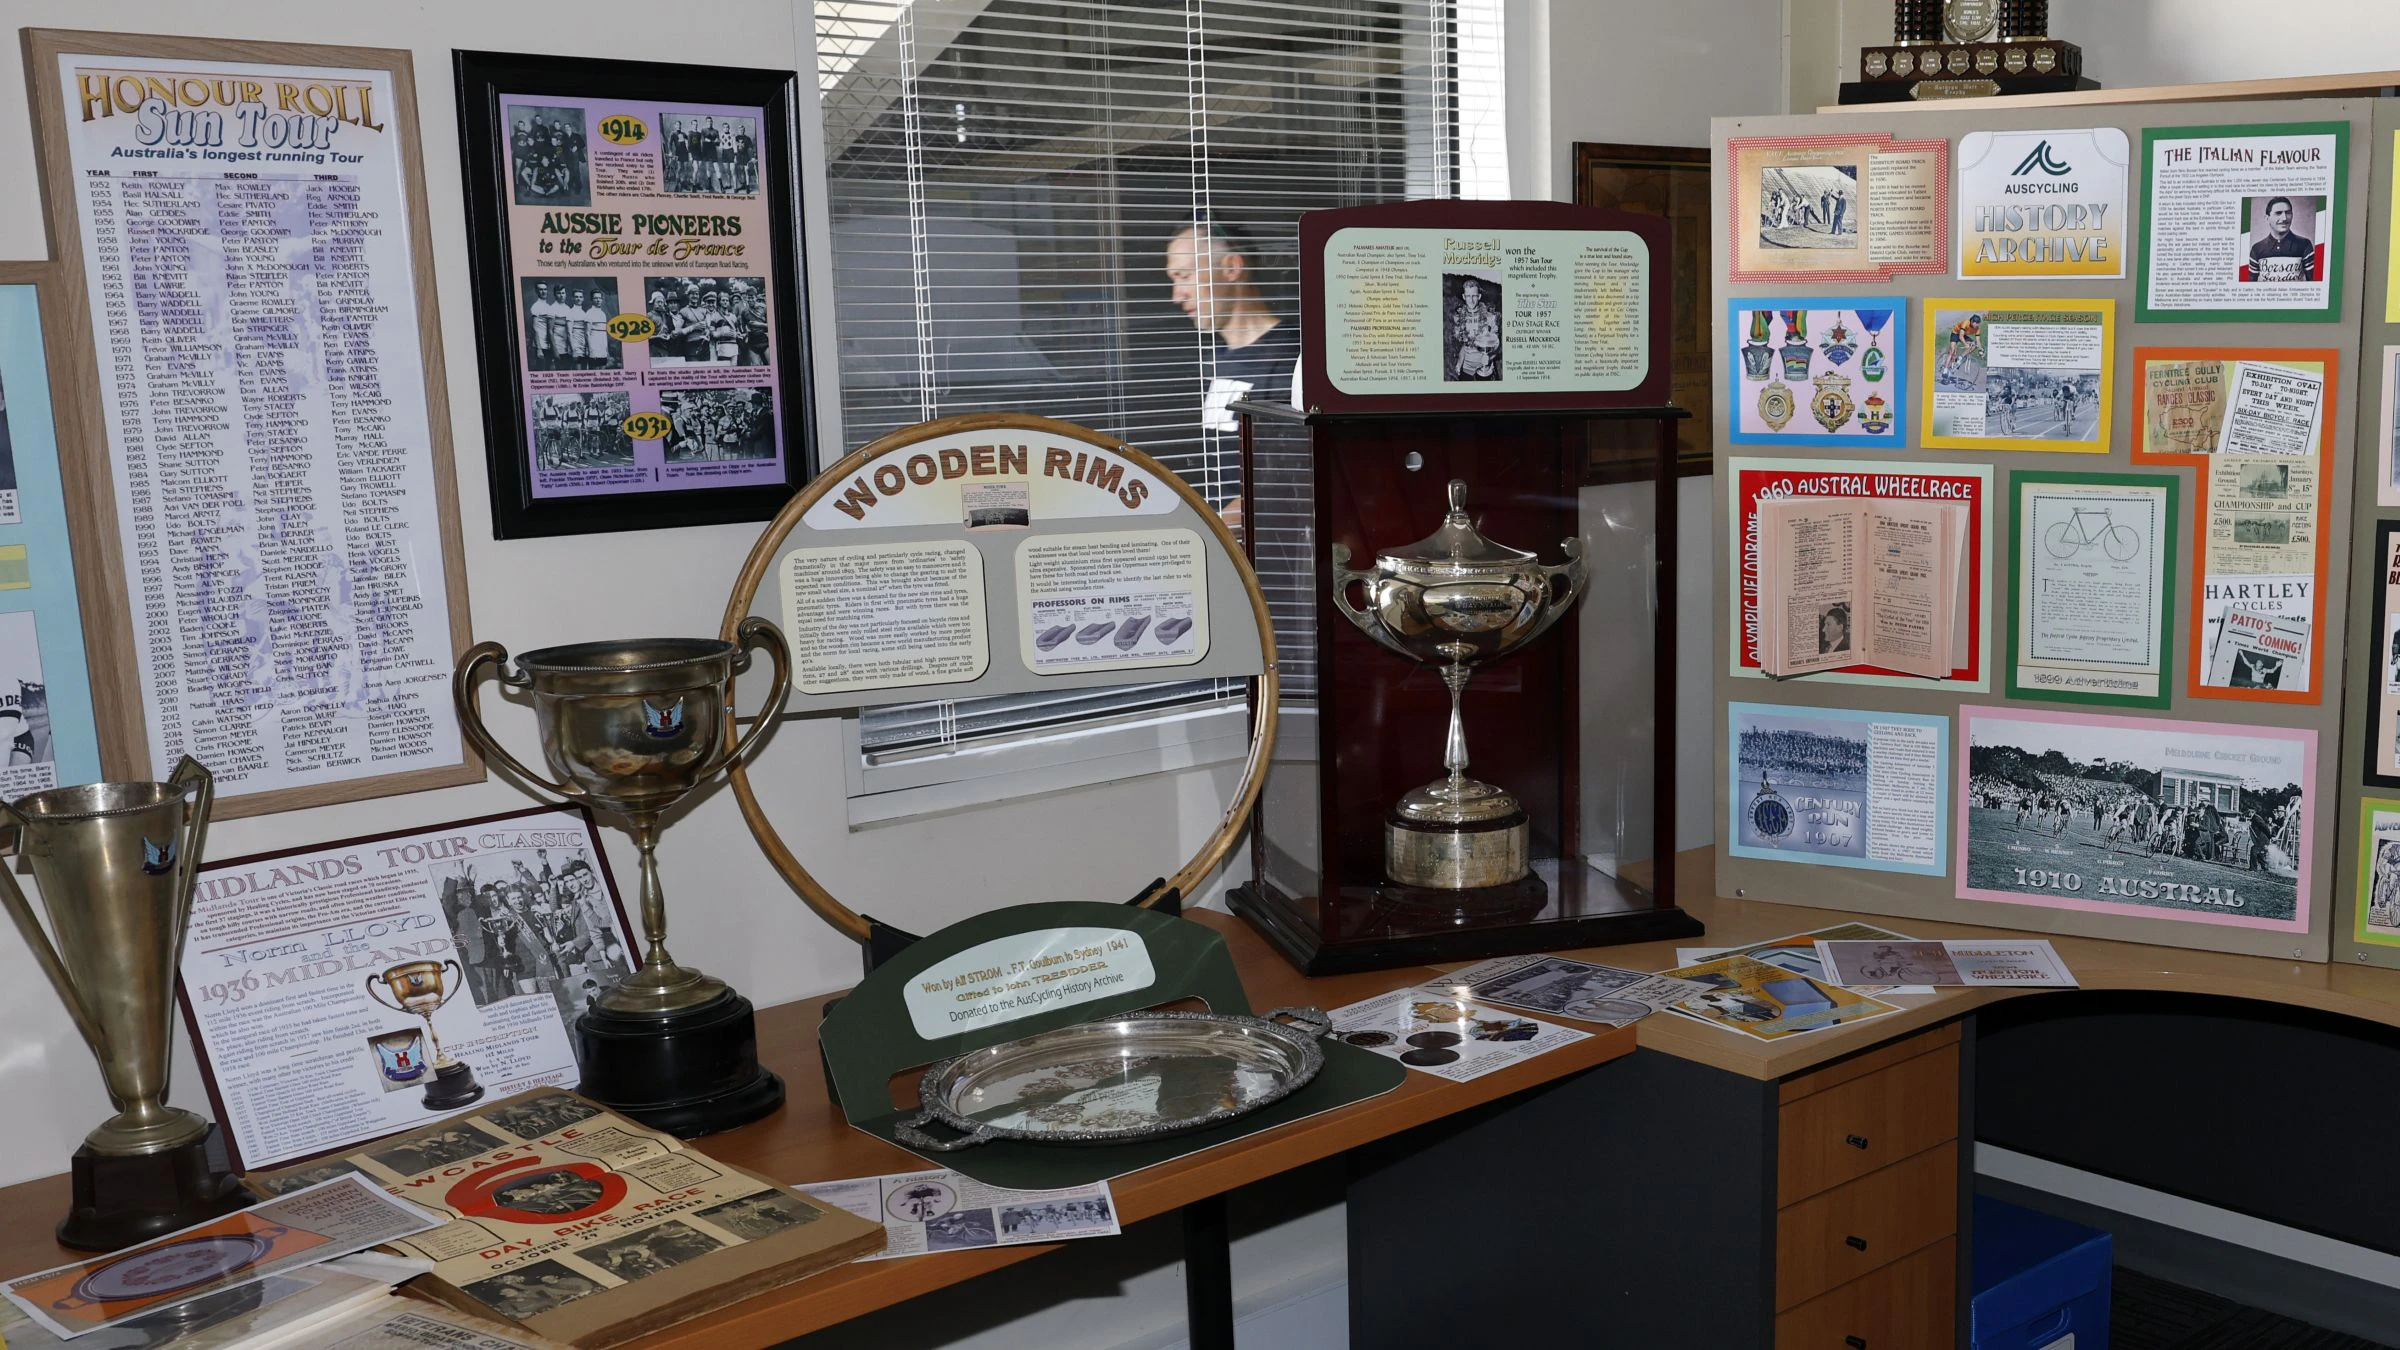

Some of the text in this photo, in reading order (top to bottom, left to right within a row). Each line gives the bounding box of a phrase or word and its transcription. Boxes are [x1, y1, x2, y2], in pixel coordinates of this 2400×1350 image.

[77, 74, 383, 133] HONOUR ROLL
[136, 97, 339, 149] Sun Tour
[602, 120, 645, 141] 1914
[111, 147, 363, 165] Australia's longest running Tour
[2165, 146, 2320, 166] THE ITALIAN FLAVOUR
[86, 169, 110, 177] YEAR
[224, 172, 258, 180] SECOND
[234, 193, 289, 201] SUTHERLAND
[2005, 183, 2079, 194] AUSCYCLING
[541, 212, 742, 236] AUSSIE PIONEERS
[1975, 204, 2108, 232] HISTORY
[158, 228, 211, 236] MOCKRIDGE
[539, 238, 745, 260] to the Tour de France
[1443, 238, 1501, 251] Russell
[1523, 246, 1536, 255] the
[1975, 236, 2107, 263] ARCHIVE
[568, 260, 595, 268] Australians
[695, 262, 718, 270] European
[1443, 252, 1502, 268] Mockridge
[1517, 299, 1557, 309] The Sun
[610, 321, 651, 338] 1928
[2150, 365, 2221, 379] FERNTREE GULLY
[2246, 372, 2318, 390] EXHIBITION OVAL
[2153, 376, 2218, 387] CYCLING CLUB
[2157, 390, 2216, 406] RANGES CLASSIC
[2242, 389, 2262, 398] EVERY
[2265, 392, 2277, 400] DAY
[2296, 399, 2314, 407] NIGHT
[2252, 398, 2270, 406] THIS
[2172, 417, 2194, 426] £300
[2238, 407, 2310, 426] SIX-DAY BICYCLE RACE
[627, 417, 668, 437] 1931
[833, 446, 1149, 520] WOODEN RIMS
[1752, 476, 1972, 505] 1960 AUSTRAL WHEELRACE
[2214, 500, 2274, 510] CHAMPIONSHIP
[2295, 502, 2312, 511] CUP
[2213, 518, 2232, 526] £500.
[2291, 536, 2310, 544] £500.
[879, 552, 908, 560] particularly
[2206, 583, 2309, 599] HARTLEY
[1033, 598, 1086, 608] PROFESSORS
[2233, 601, 2283, 611] CYCLES
[2230, 613, 2273, 632] PATTO'S
[2252, 645, 2269, 653] World
[2271, 650, 2298, 660] Champion
[2259, 634, 2302, 654] COMING!
[303, 702, 346, 713] DONNELLY
[307, 751, 344, 761] SCHULTZ
[400, 747, 434, 758] HOWSON
[2165, 747, 2282, 764] MELBOURNE CRICKET GROUND
[1794, 796, 1862, 819] CENTURY
[1808, 812, 1849, 827] RUN
[1804, 831, 1852, 848] 1907
[377, 837, 477, 869] TOUR
[478, 831, 584, 850] CLASSIC
[2014, 868, 2245, 908] 1910 AUSTRAL
[220, 914, 436, 967] Norm LLOYD
[301, 942, 371, 963] and the
[199, 933, 472, 1006] 1936 MIDLANDS
[922, 938, 1129, 994] Won by STROM F.T. Goulburn to Sydney 1941
[955, 962, 1108, 1002] Gifted to John TRESIDDER
[949, 973, 1124, 1022] Donated to the AusCycling History Archive
[454, 1034, 540, 1058] HEALING MIDLANDS TOUR
[386, 1128, 584, 1196] EWCASTLE
[480, 1187, 705, 1260] DAY BIKE RACE
[520, 1200, 684, 1255] MITCHELL PARK CYCLING TRACK
[491, 1199, 704, 1270] OCTOBER 29 NOVEMBER
